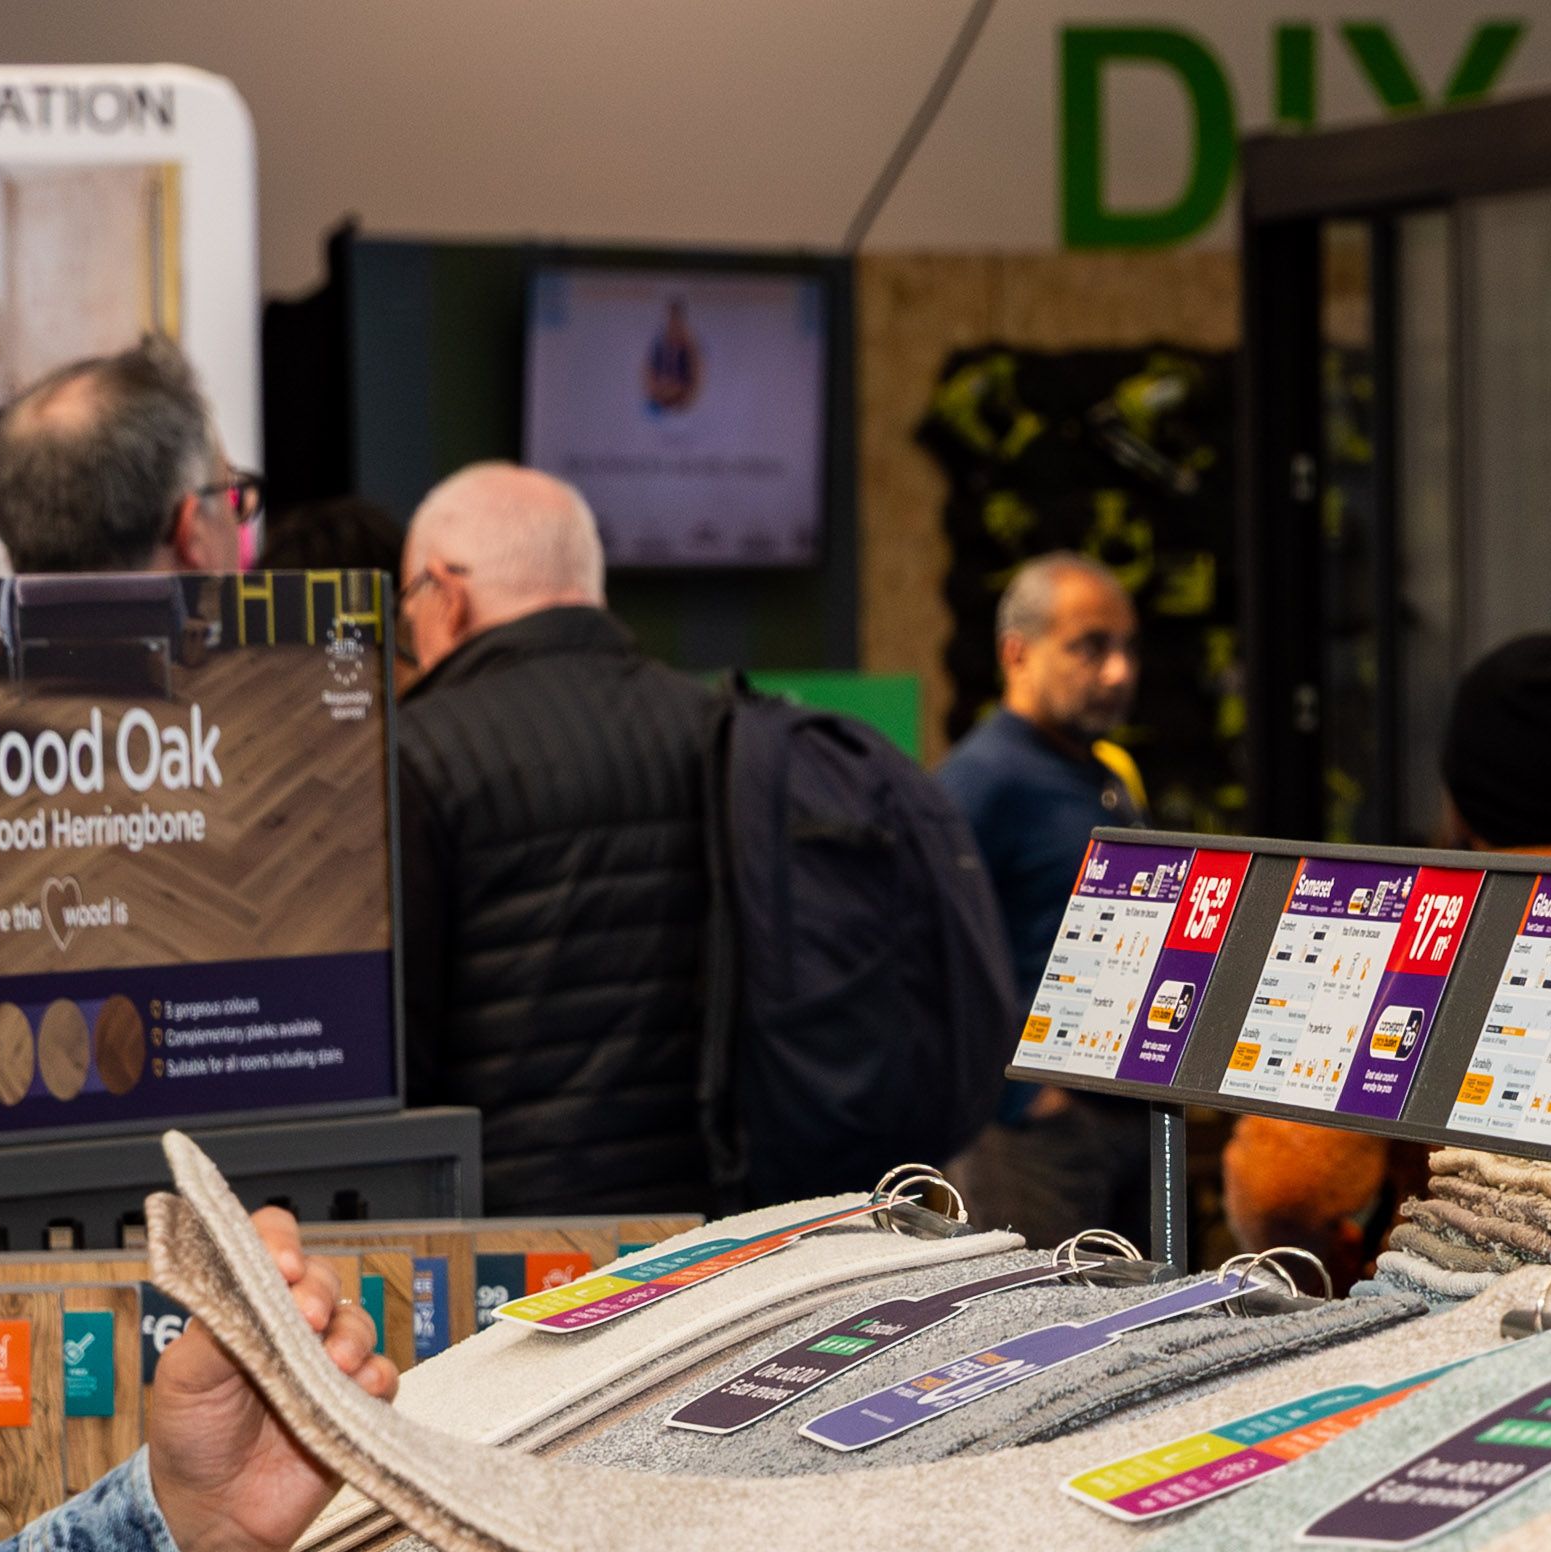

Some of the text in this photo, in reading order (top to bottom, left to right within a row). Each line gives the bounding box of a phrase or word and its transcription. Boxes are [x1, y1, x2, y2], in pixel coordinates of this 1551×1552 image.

[116, 703, 224, 793] Oak
[52, 803, 206, 852] Herringbone
[1295, 873, 1335, 898] Somerset
[13, 902, 42, 932] the
[62, 898, 111, 928] wood
[113, 899, 129, 926] is
[1184, 876, 1232, 939] £15.99
[1409, 893, 1464, 961] £17.99
[166, 1026, 246, 1047] Complementary
[166, 1058, 208, 1078] Suitable
[754, 1362, 785, 1380] Over
[748, 1384, 794, 1401] reviews
